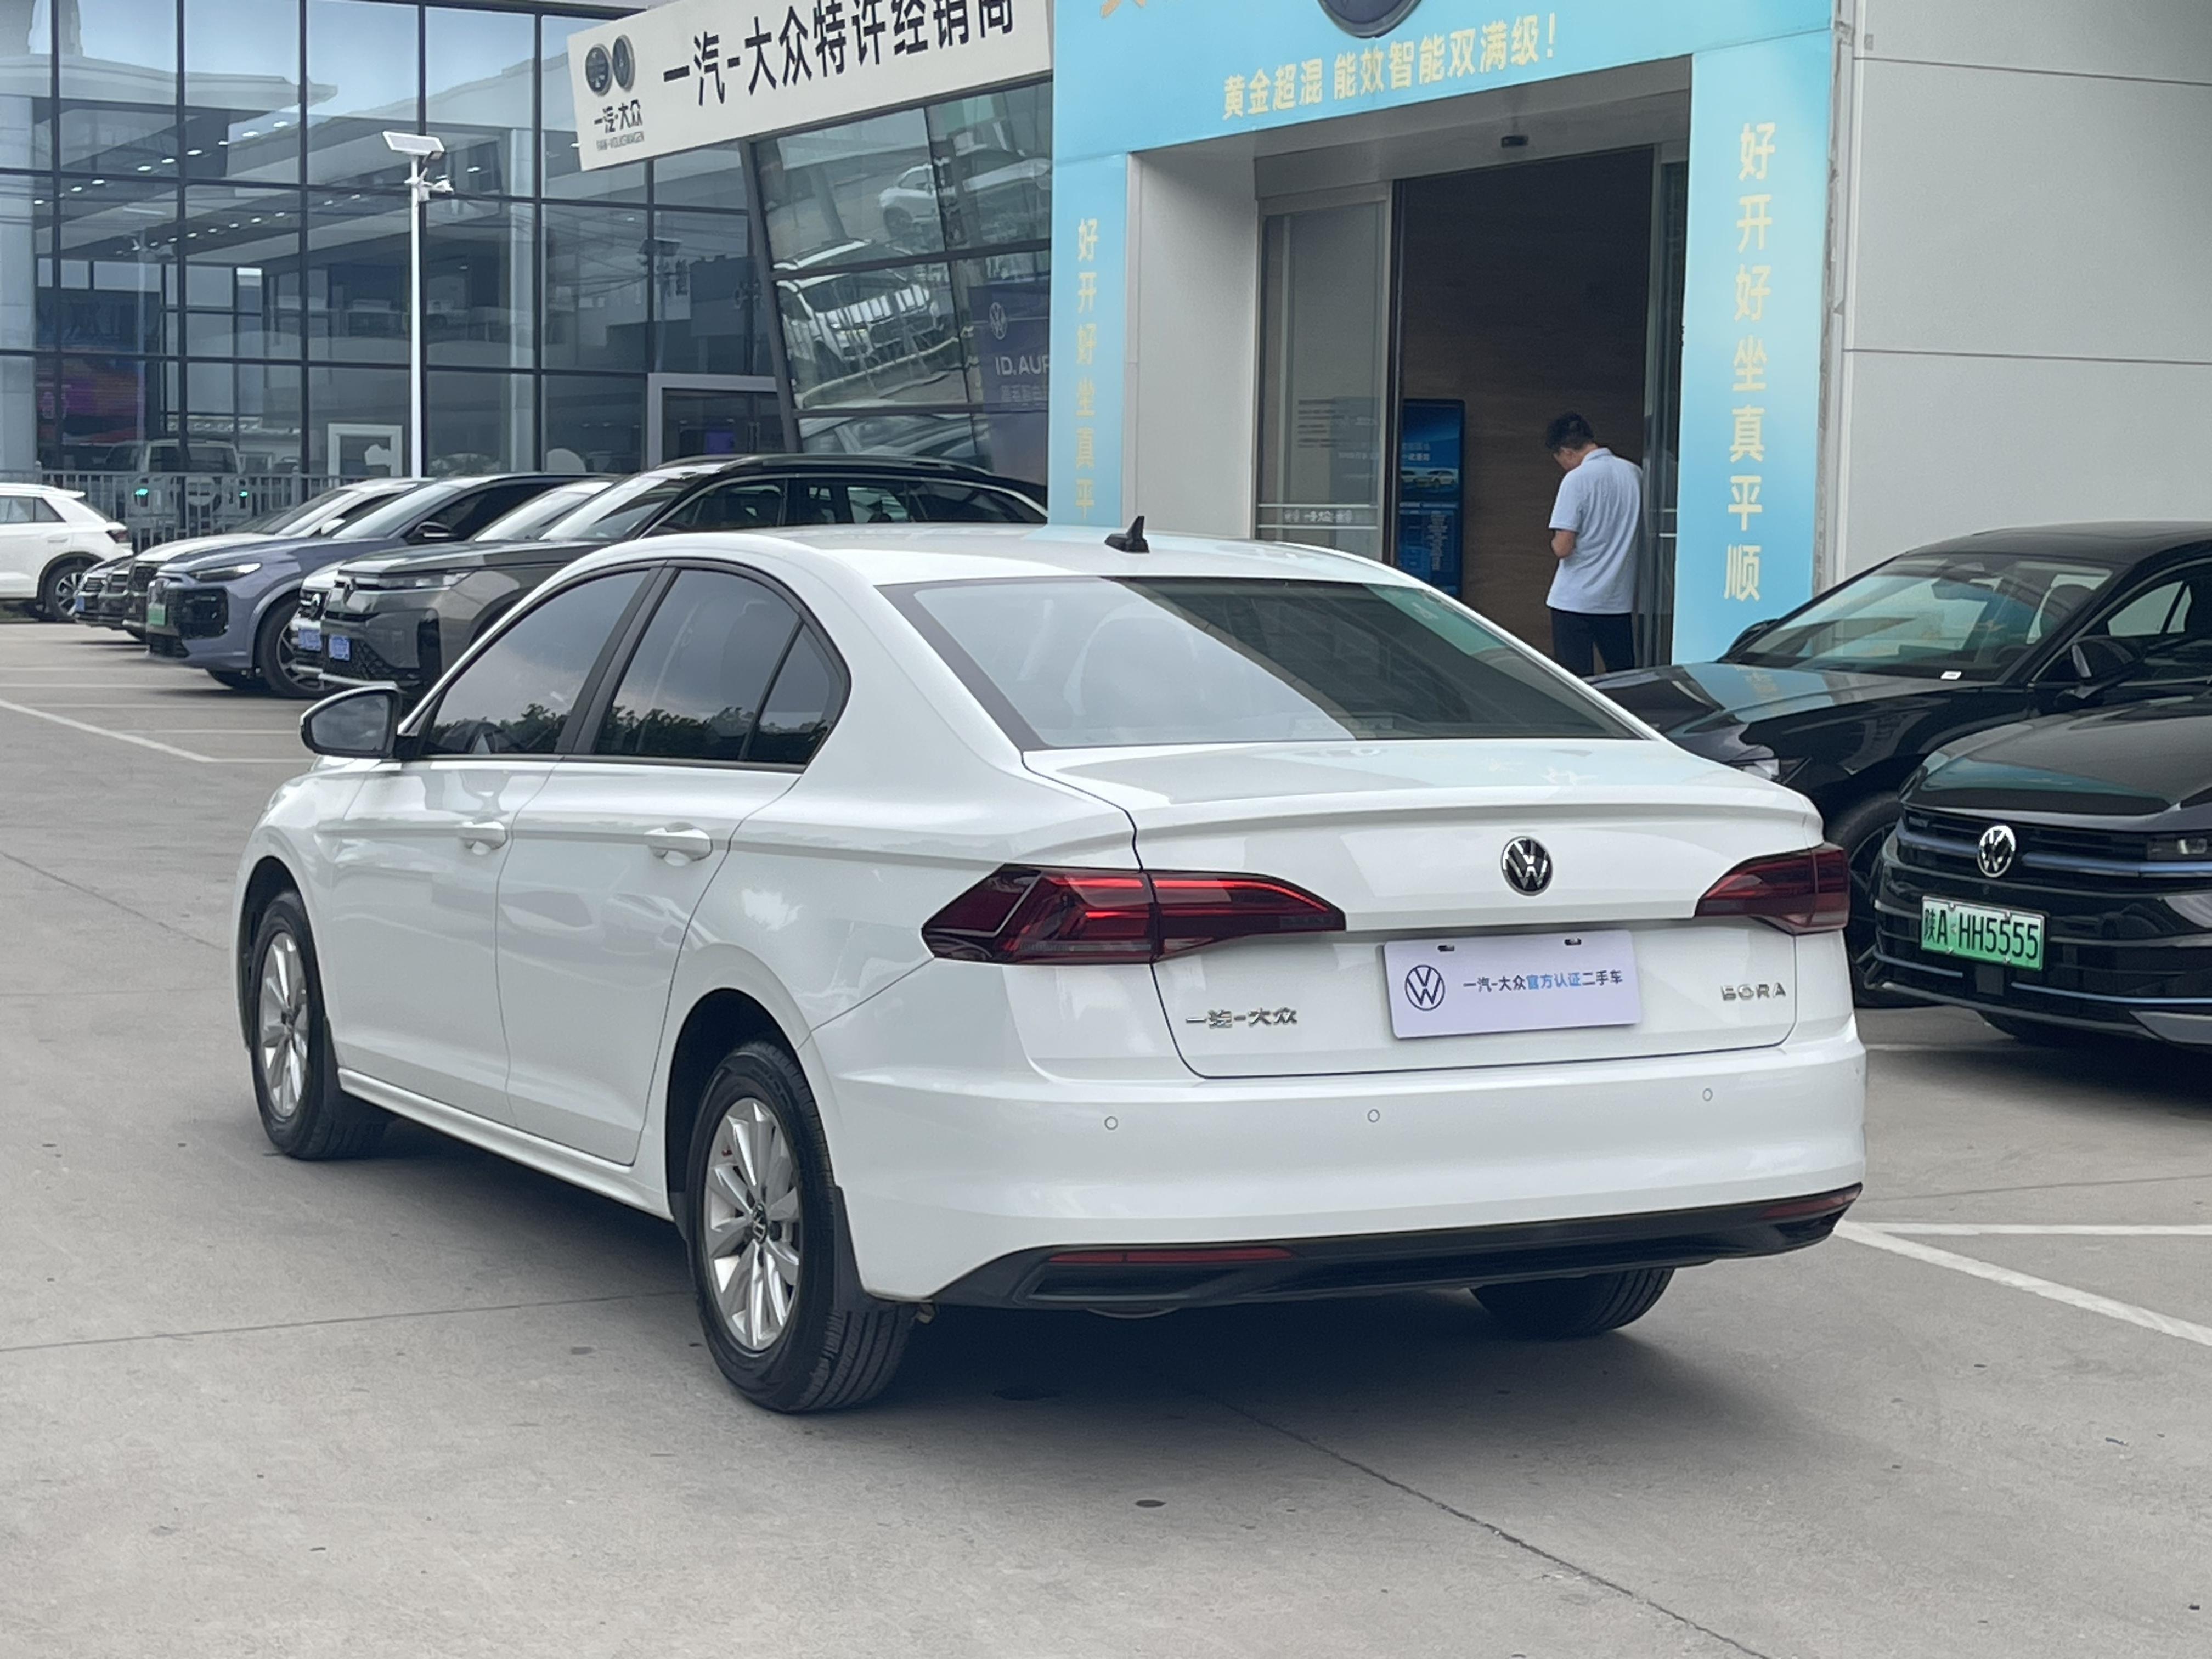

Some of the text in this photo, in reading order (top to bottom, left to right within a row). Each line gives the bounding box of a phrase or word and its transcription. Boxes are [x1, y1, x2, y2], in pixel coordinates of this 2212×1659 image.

[1222, 58, 1323, 120] 黄金超混
[1075, 218, 1098, 519] 好开好坐真平
[1723, 122, 1776, 601] 好开好坐真平顺
[1463, 970, 1623, 992] 一汽-大众官方认证二手车
[1720, 981, 1786, 1001] BORA
